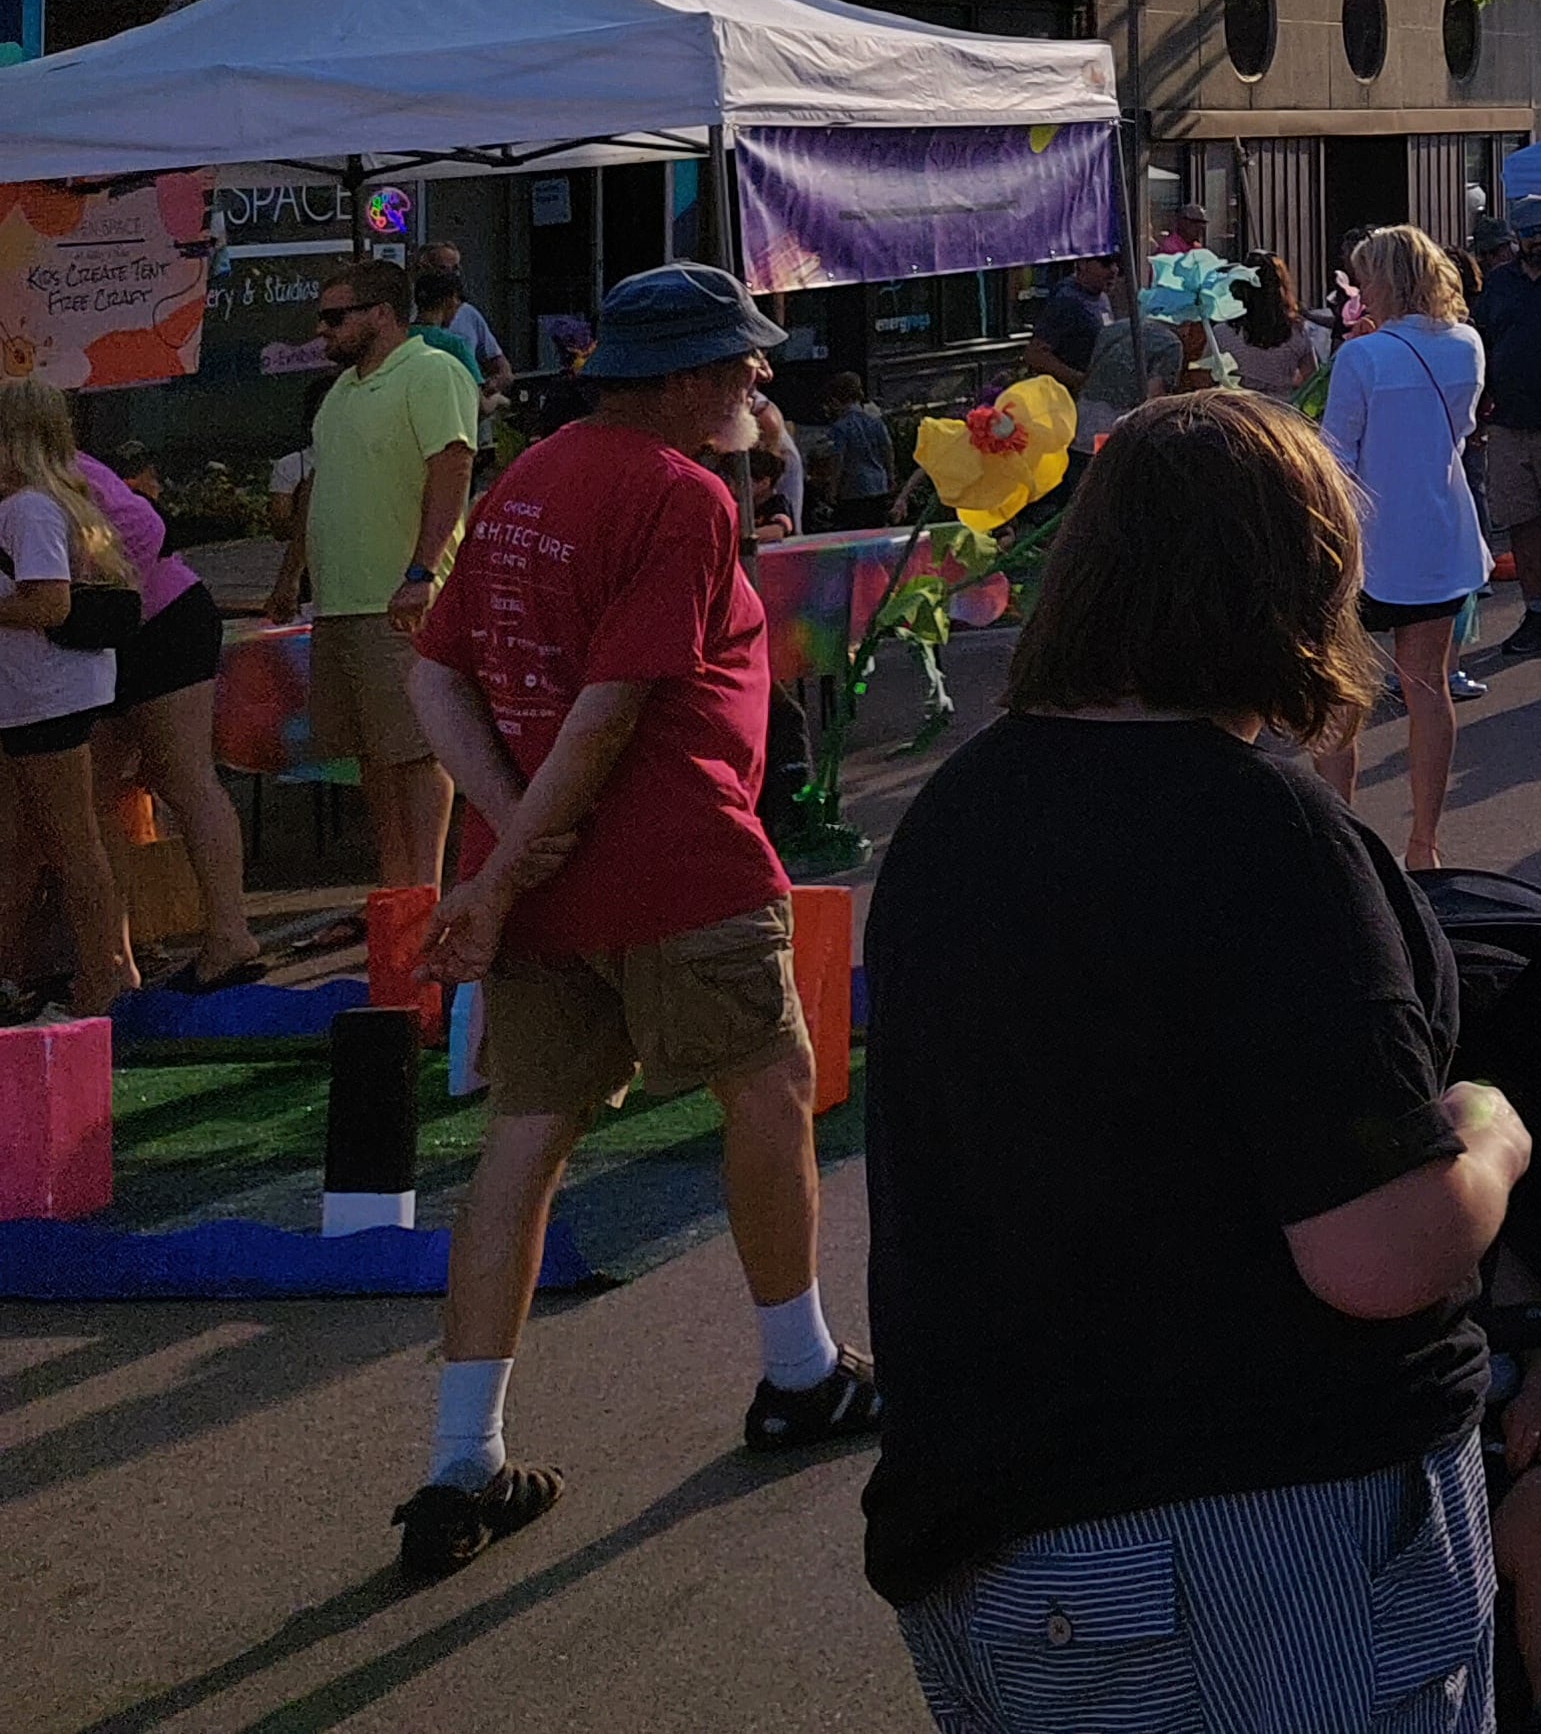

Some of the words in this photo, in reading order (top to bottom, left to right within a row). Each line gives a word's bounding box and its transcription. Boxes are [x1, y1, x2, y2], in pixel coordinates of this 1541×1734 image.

[227, 185, 353, 225] SPACE
[66, 262, 127, 288] CREATE
[131, 256, 172, 284] TENT
[48, 289, 90, 315] FREE
[94, 288, 154, 313] CRAFT
[264, 274, 320, 304] Studios
